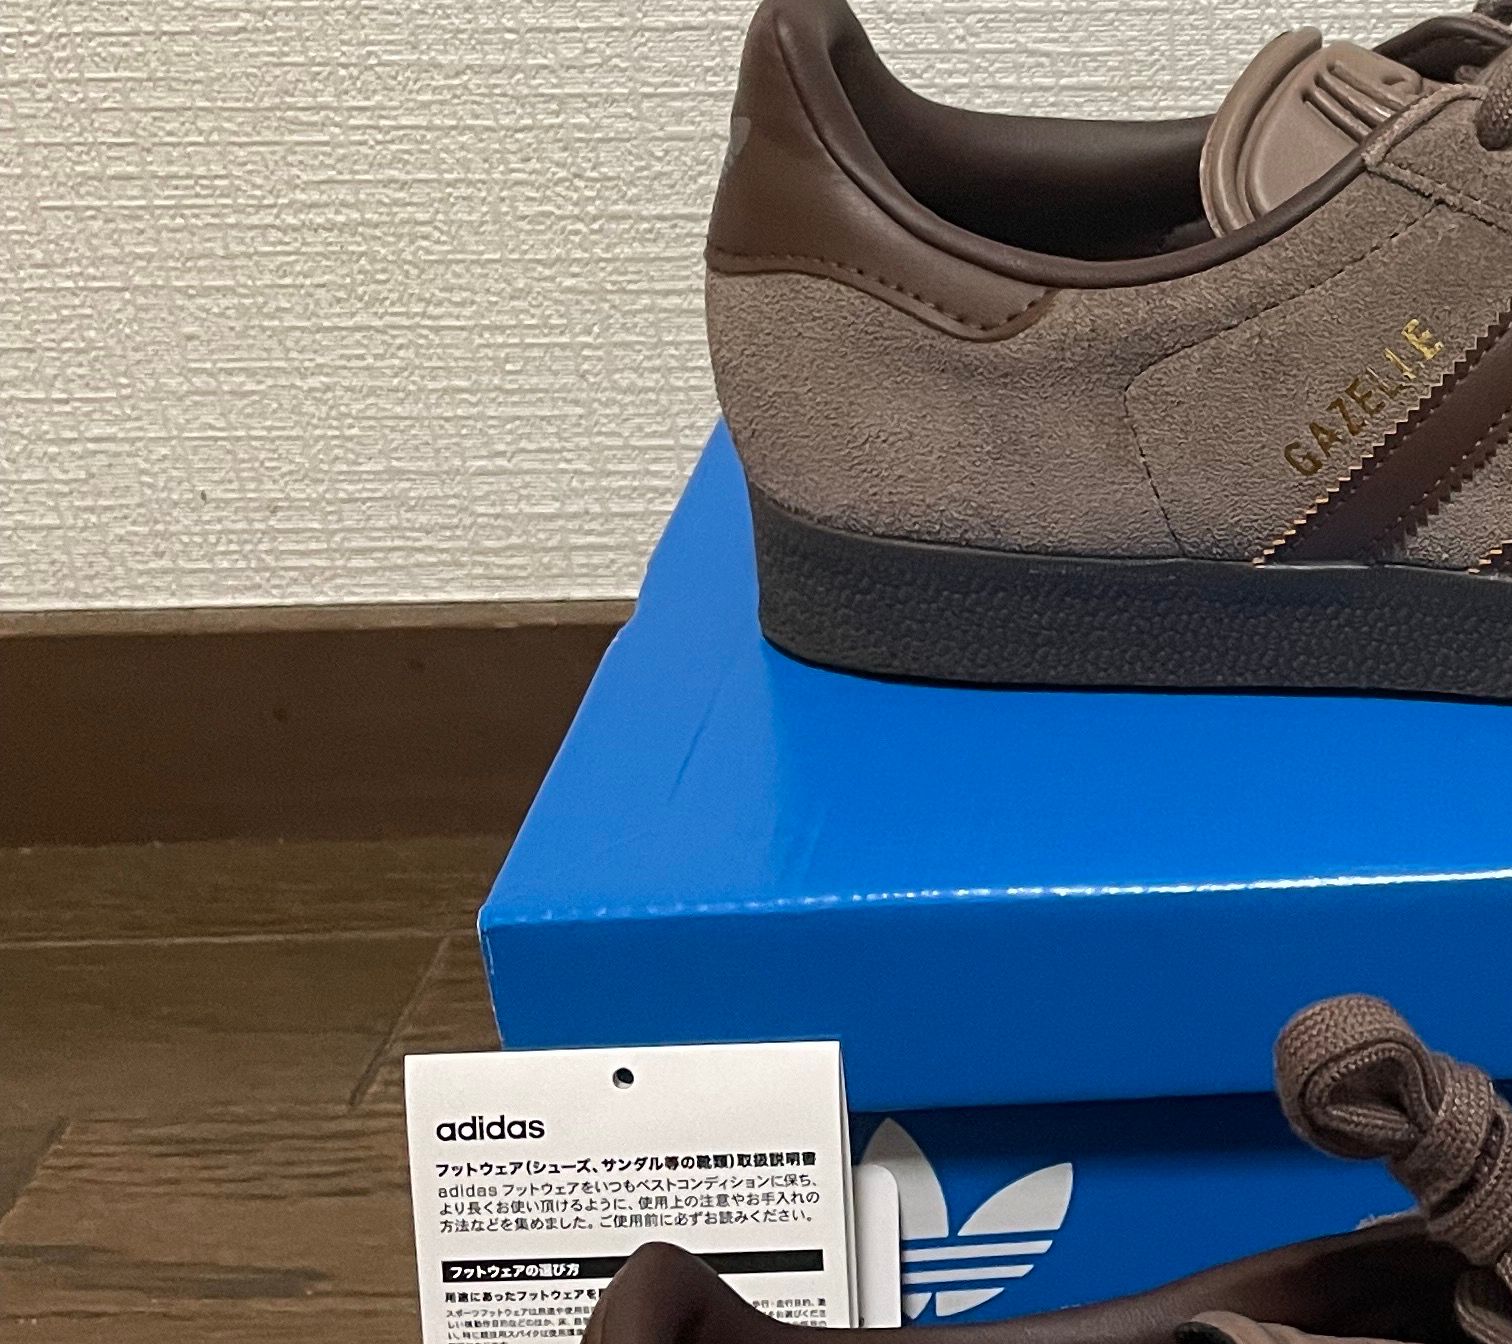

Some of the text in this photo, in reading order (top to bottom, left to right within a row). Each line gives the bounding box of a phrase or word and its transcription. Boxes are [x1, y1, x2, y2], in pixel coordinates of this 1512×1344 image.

[1283, 317, 1444, 477] GAZELLE
[435, 1114, 546, 1142] adidas
[438, 1173, 818, 1198] adidas フットウェアをいつもベストコンディションに保ち、
[439, 1191, 821, 1216] より長くお使い頂けるように、使用上の注意やお手入れの
[439, 1209, 814, 1234] 方法などを集めました。ご使用前に必ずお読みください。
[450, 1263, 580, 1279] フットウェアの選び方
[444, 1288, 604, 1303] 用途にあったフットウェアを
